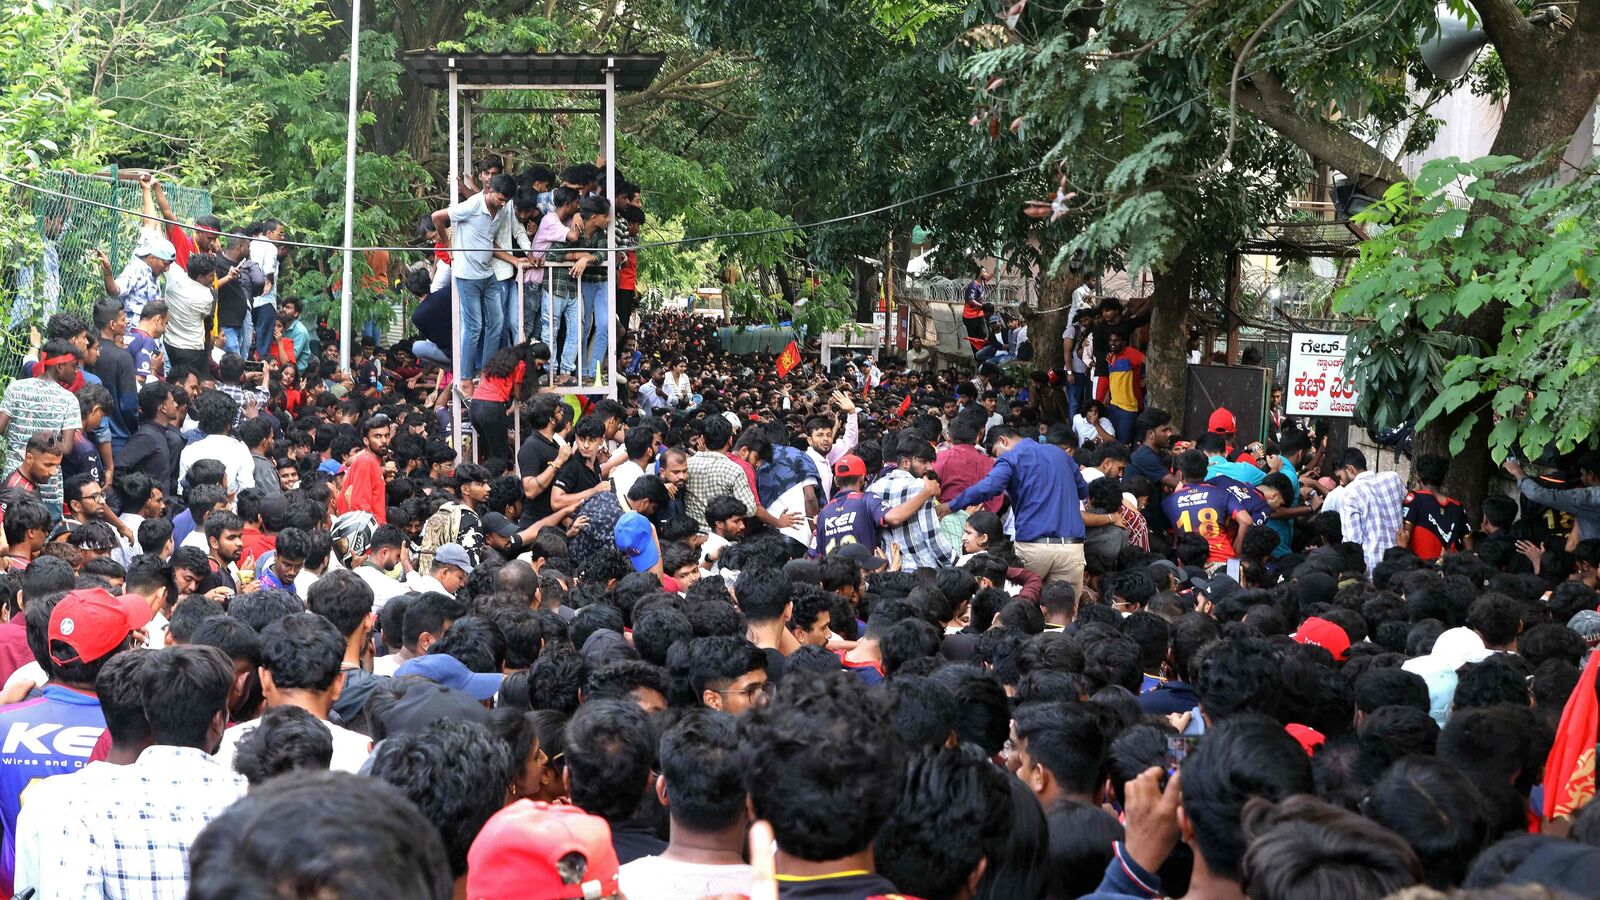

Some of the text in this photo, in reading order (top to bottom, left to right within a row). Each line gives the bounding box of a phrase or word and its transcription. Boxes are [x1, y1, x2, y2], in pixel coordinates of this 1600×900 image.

[1177, 492, 1208, 503] KEI
[825, 512, 857, 532] KEI
[1176, 507, 1219, 539] 18
[45, 759, 68, 767] and
